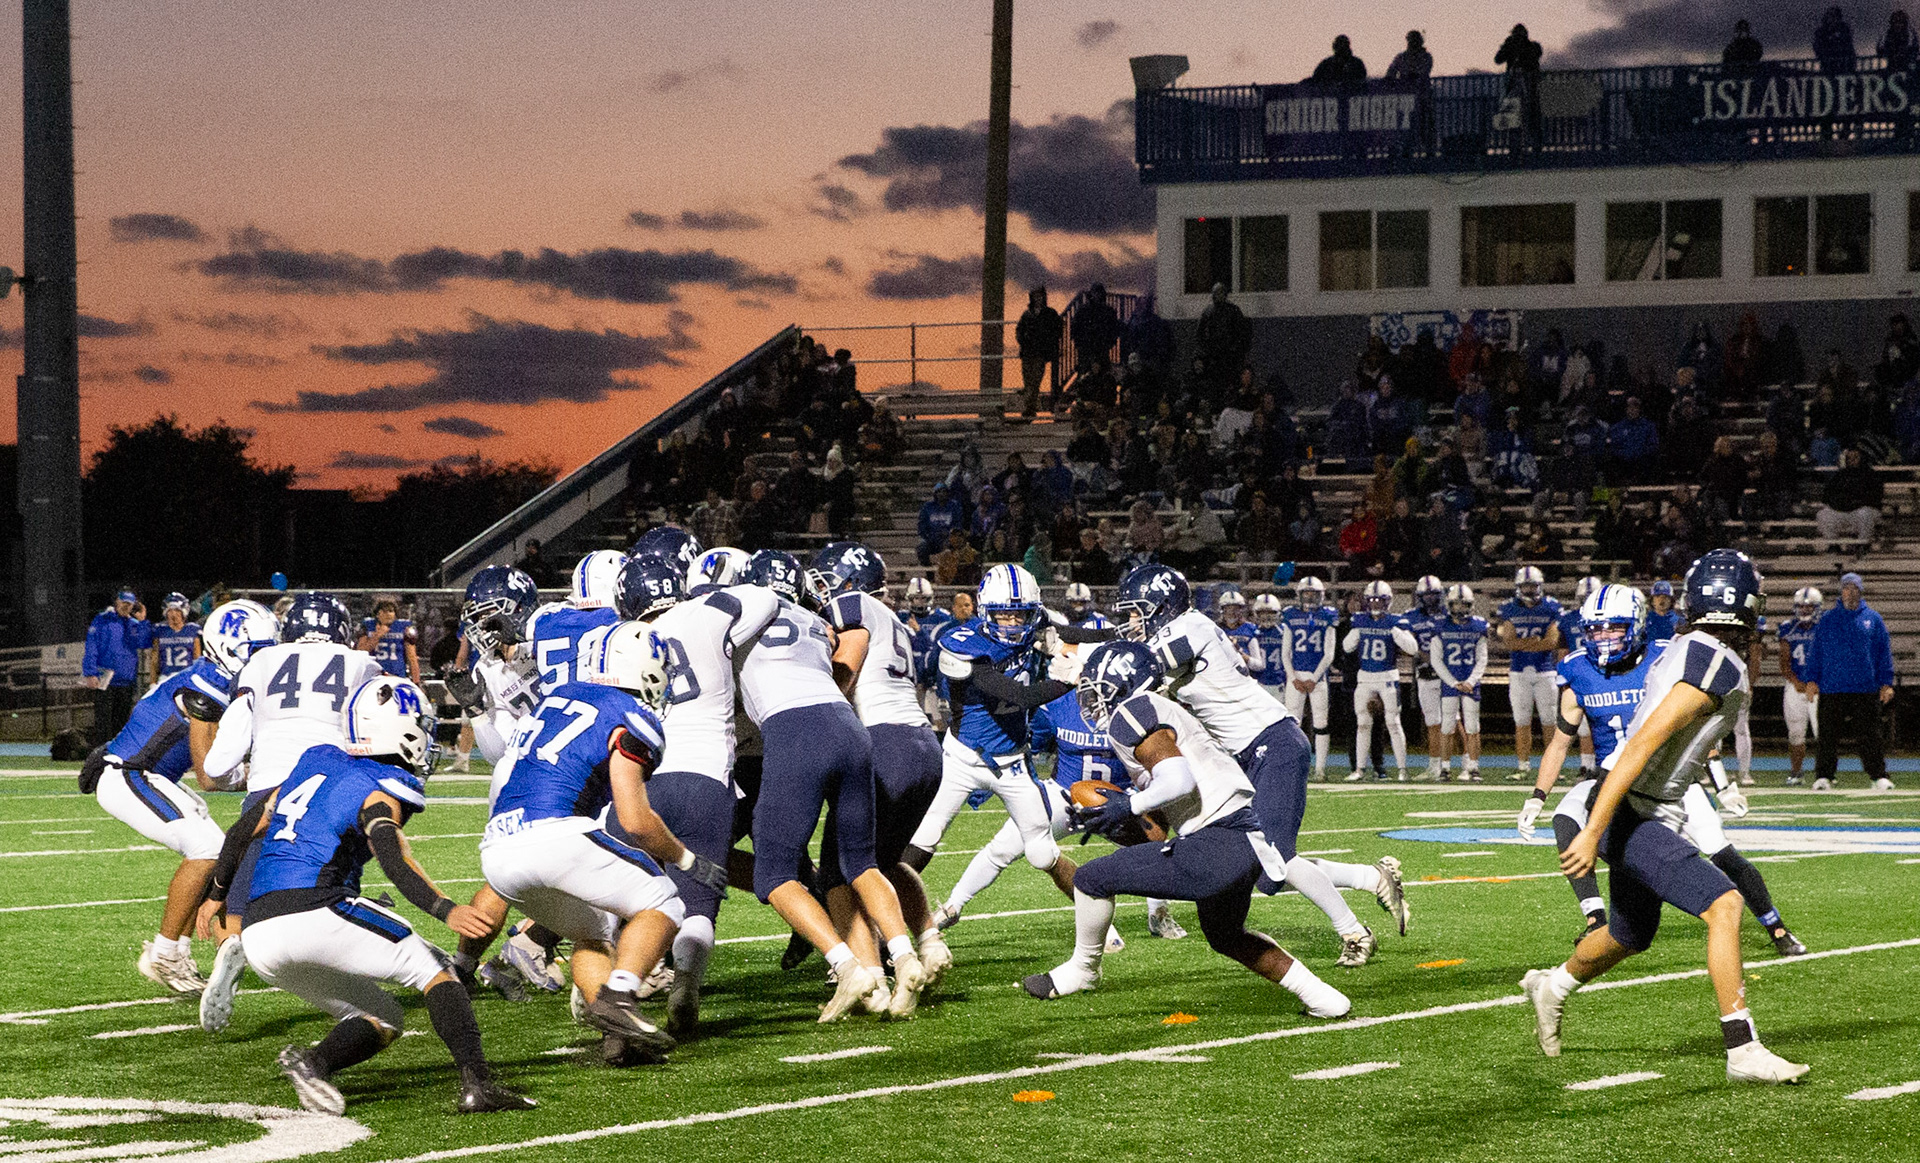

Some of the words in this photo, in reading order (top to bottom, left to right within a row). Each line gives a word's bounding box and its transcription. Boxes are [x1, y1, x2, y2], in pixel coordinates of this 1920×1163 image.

[1701, 71, 1908, 121] ISLANDERS
[1265, 97, 1340, 135] SENIOR
[1348, 93, 1416, 131] NIGHT
[650, 578, 673, 596] 58
[1723, 586, 1736, 605] 6
[218, 608, 250, 638] M
[951, 626, 976, 642] 2
[375, 642, 398, 661] 51
[1294, 628, 1322, 652] 24
[1361, 638, 1387, 661] 18
[165, 646, 189, 666] 12
[1445, 642, 1476, 666] 23
[266, 653, 349, 713] 44
[393, 683, 422, 717] M
[273, 773, 328, 844] 4
